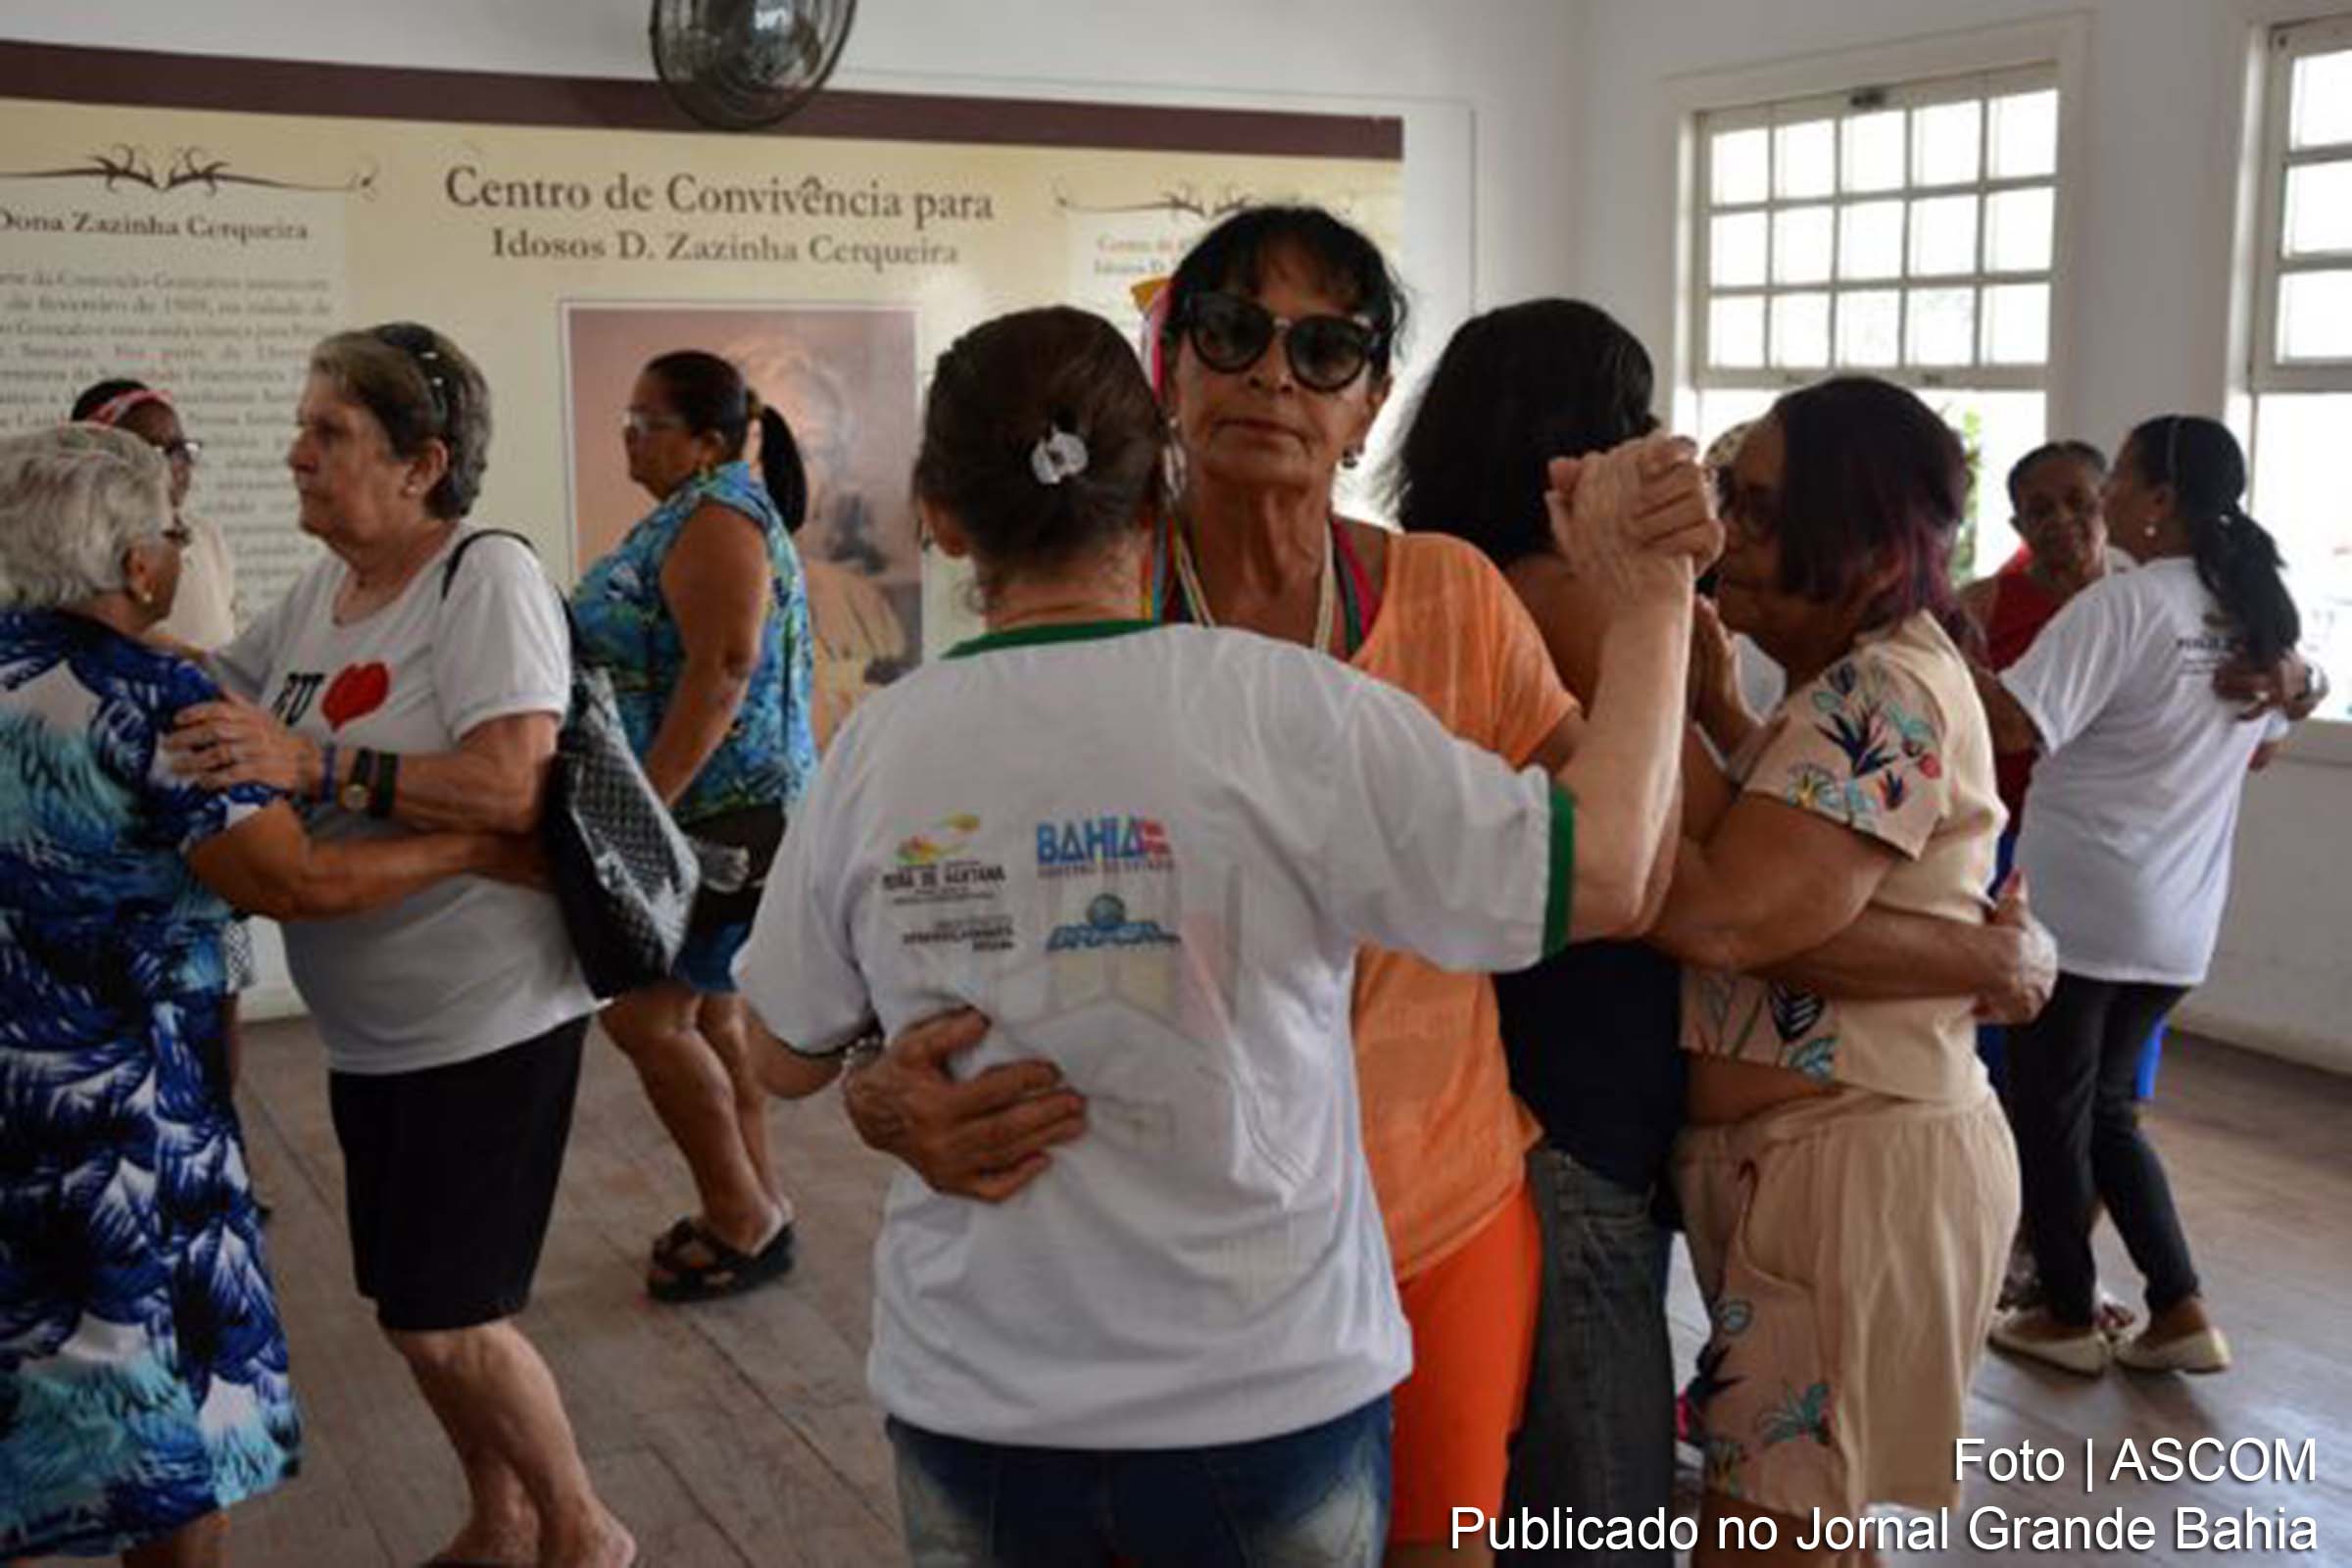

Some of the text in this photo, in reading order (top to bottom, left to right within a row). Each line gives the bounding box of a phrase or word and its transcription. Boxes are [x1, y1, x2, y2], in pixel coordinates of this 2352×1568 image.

[445, 166, 996, 229] Centro de Convivência para
[71, 211, 179, 237] Zazinha
[186, 217, 309, 245] Cerqueira
[492, 227, 959, 272] Idosos D. Zazinha Cerqueira
[1037, 816, 1145, 864] BAHIA
